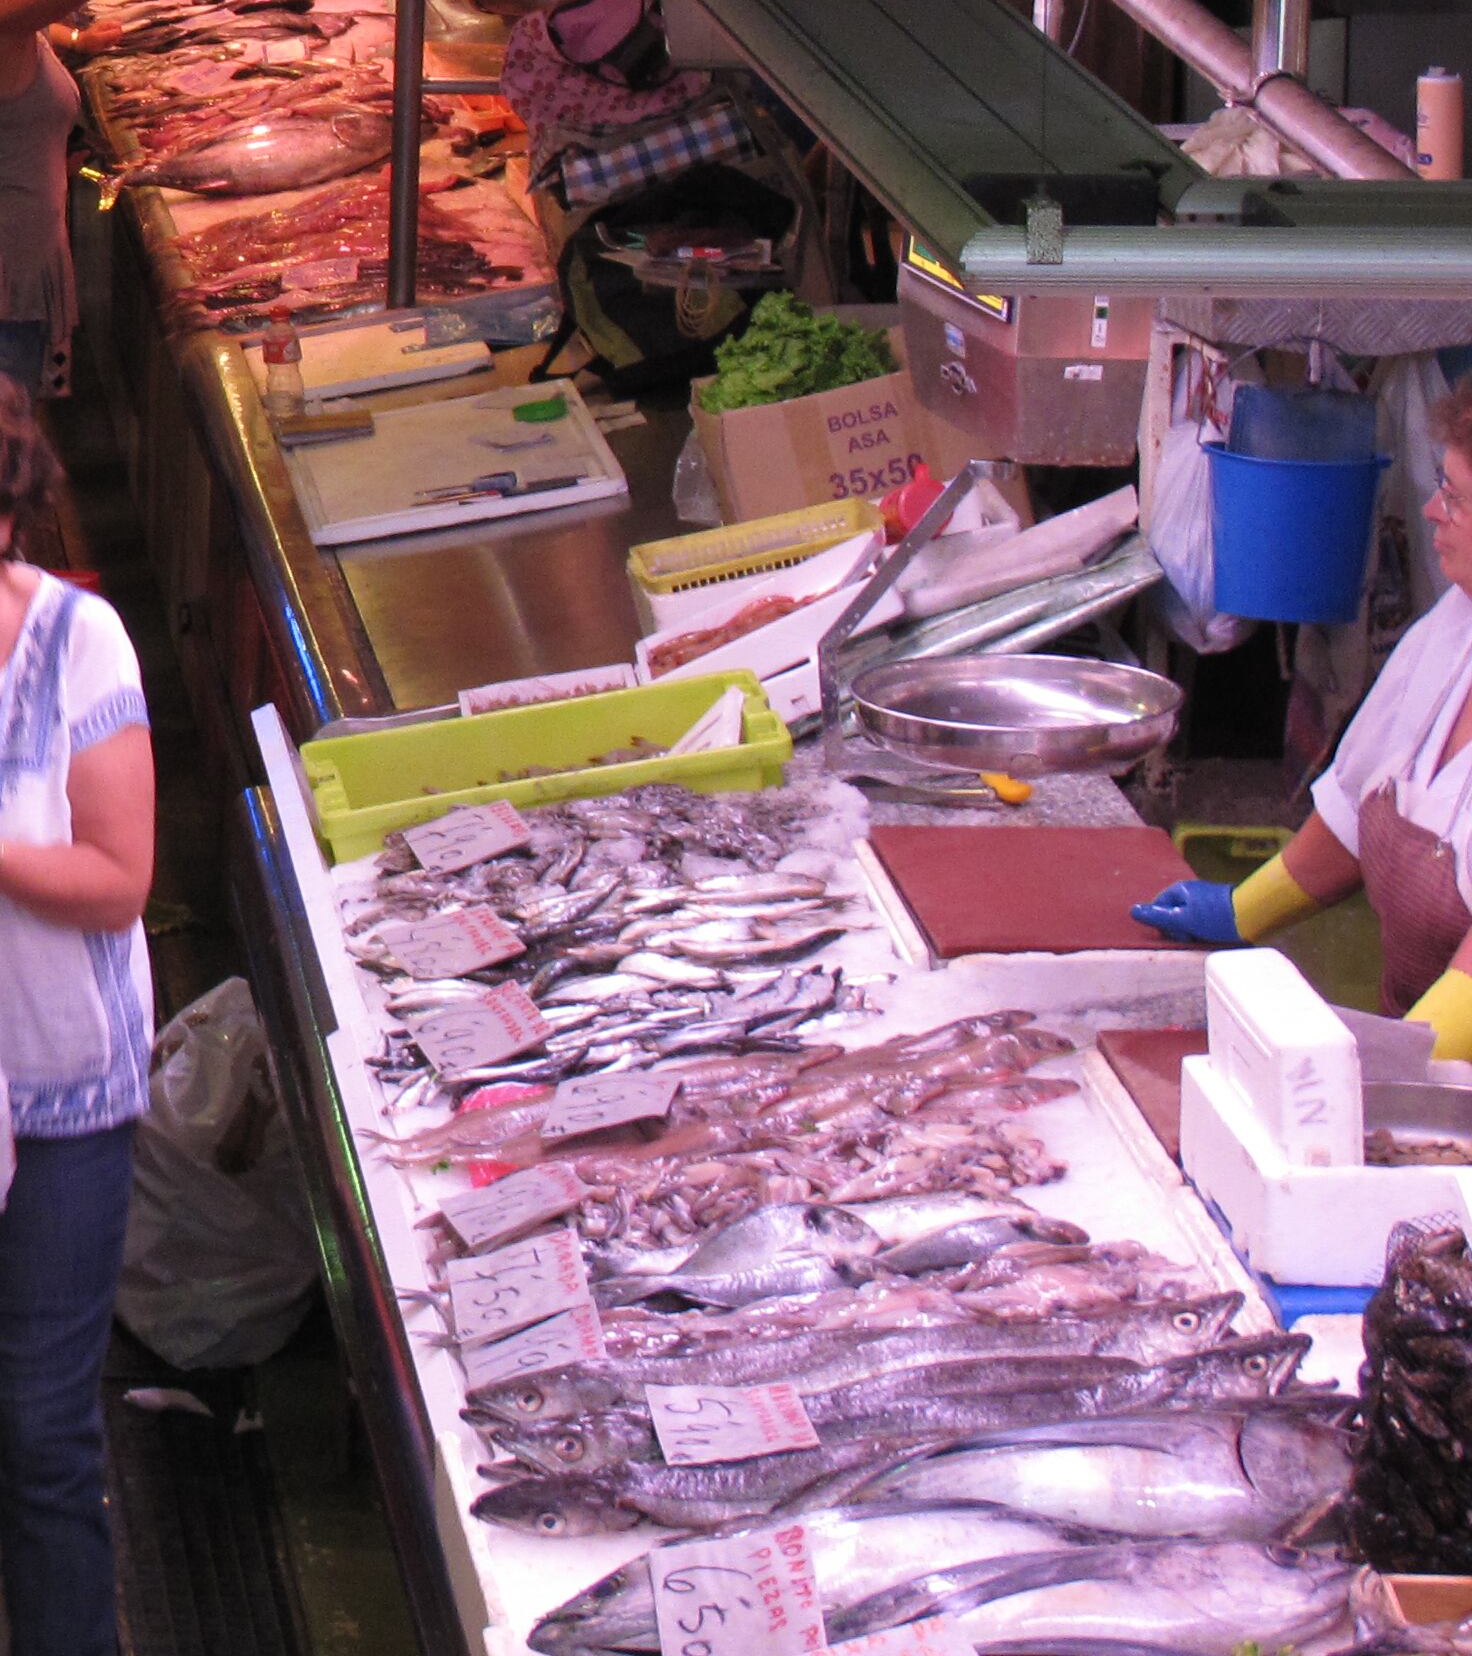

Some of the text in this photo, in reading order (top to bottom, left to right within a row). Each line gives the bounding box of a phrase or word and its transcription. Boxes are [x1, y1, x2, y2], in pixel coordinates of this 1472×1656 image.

[827, 402, 898, 433] BOLSA
[848, 429, 890, 454] ASA
[750, 1547, 788, 1633] PIEZAS
[775, 1525, 815, 1609] BONITO
